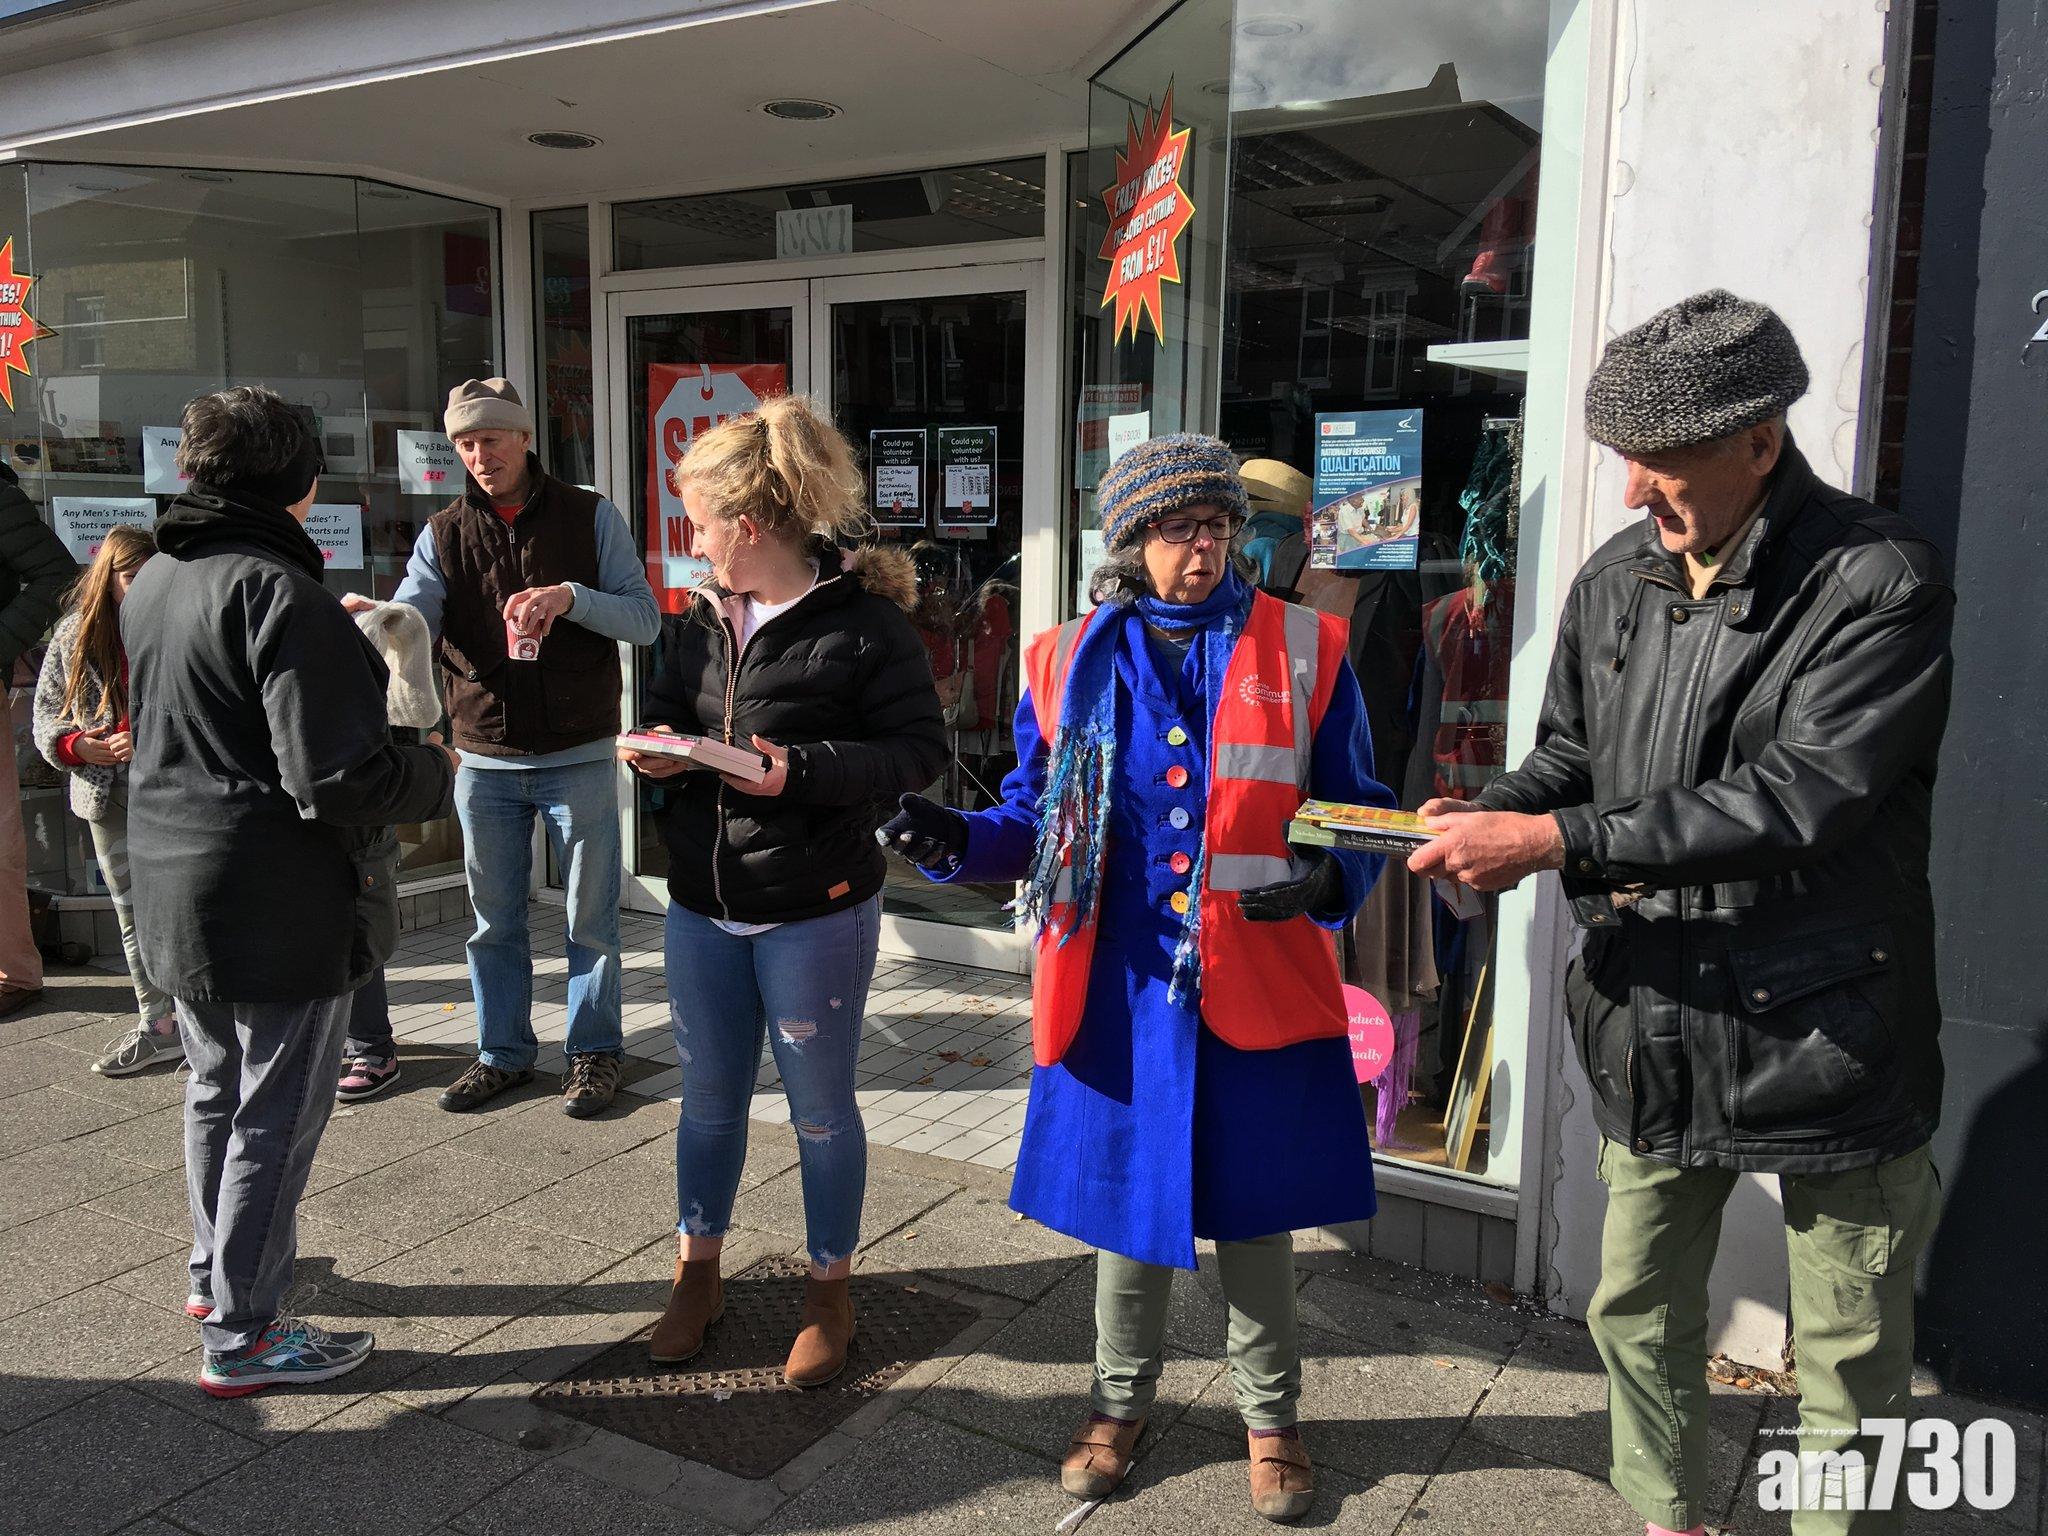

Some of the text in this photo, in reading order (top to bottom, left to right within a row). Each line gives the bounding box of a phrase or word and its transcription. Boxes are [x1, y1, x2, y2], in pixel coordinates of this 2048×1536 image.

[1115, 145, 1179, 218] CRAZY PRICES!
[1113, 190, 1176, 250] PRE-LOVED CLOTHING
[1120, 228, 1168, 287] FROM £1!
[0, 282, 22, 304] ES!
[415, 442, 454, 454] Any 5 Baby
[901, 440, 914, 450] you
[971, 438, 984, 449] you
[951, 447, 983, 455] volunteer
[415, 456, 454, 466] clothes for
[900, 457, 911, 465] us?
[1320, 455, 1401, 473] QUALIFICATION
[62, 509, 79, 518] Any
[112, 509, 148, 519] T-shirts,
[304, 515, 342, 523] adies’ T-
[69, 521, 98, 529] Shorts
[304, 526, 350, 535] Shorts and
[316, 539, 349, 547] Dresses
